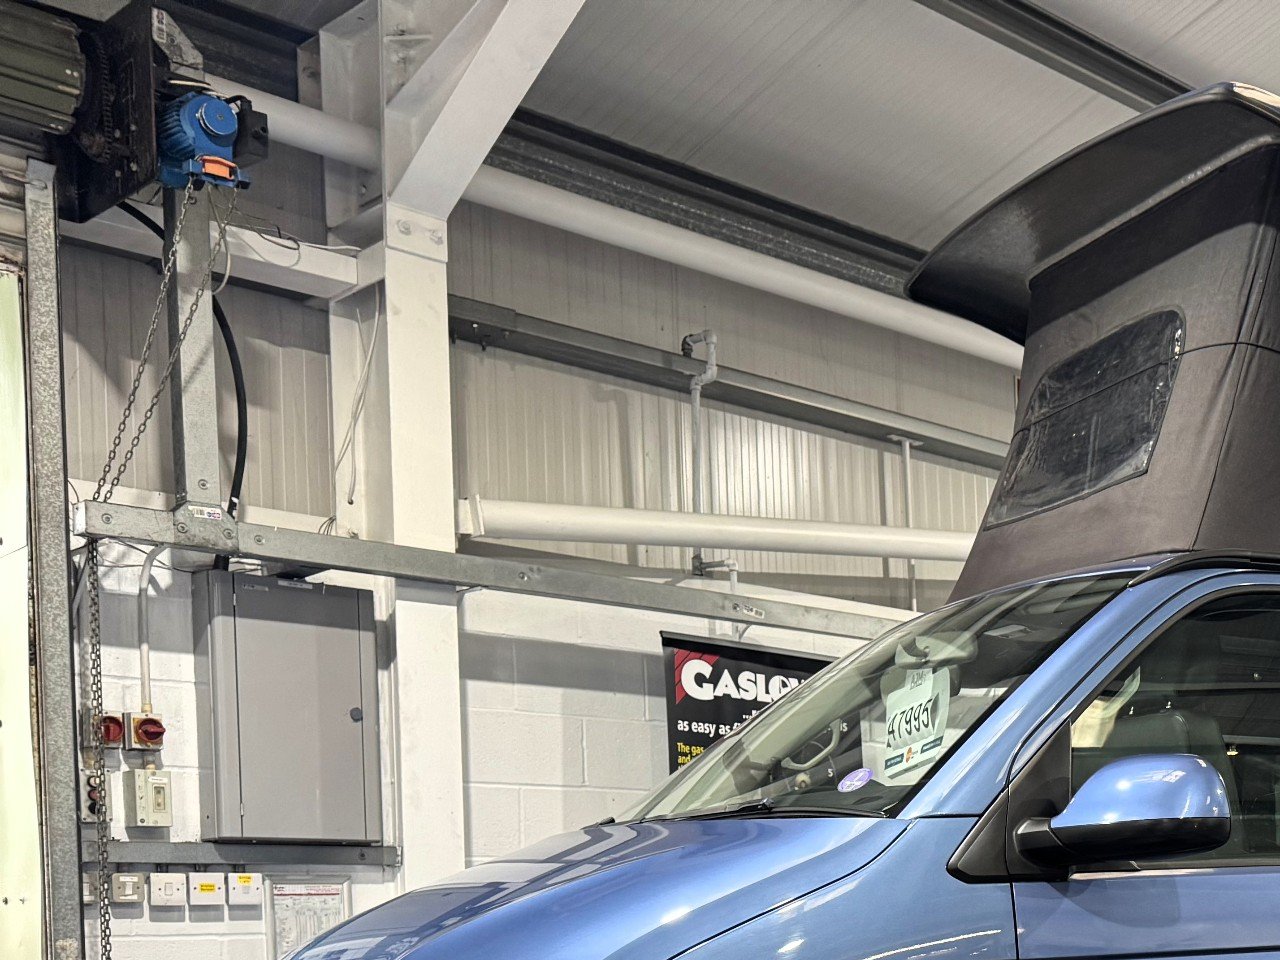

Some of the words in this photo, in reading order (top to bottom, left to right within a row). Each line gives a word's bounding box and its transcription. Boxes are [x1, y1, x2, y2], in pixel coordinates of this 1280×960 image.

[677, 720, 689, 731] as
[691, 722, 716, 737] easy
[718, 724, 730, 735] as
[677, 742, 690, 753] The
